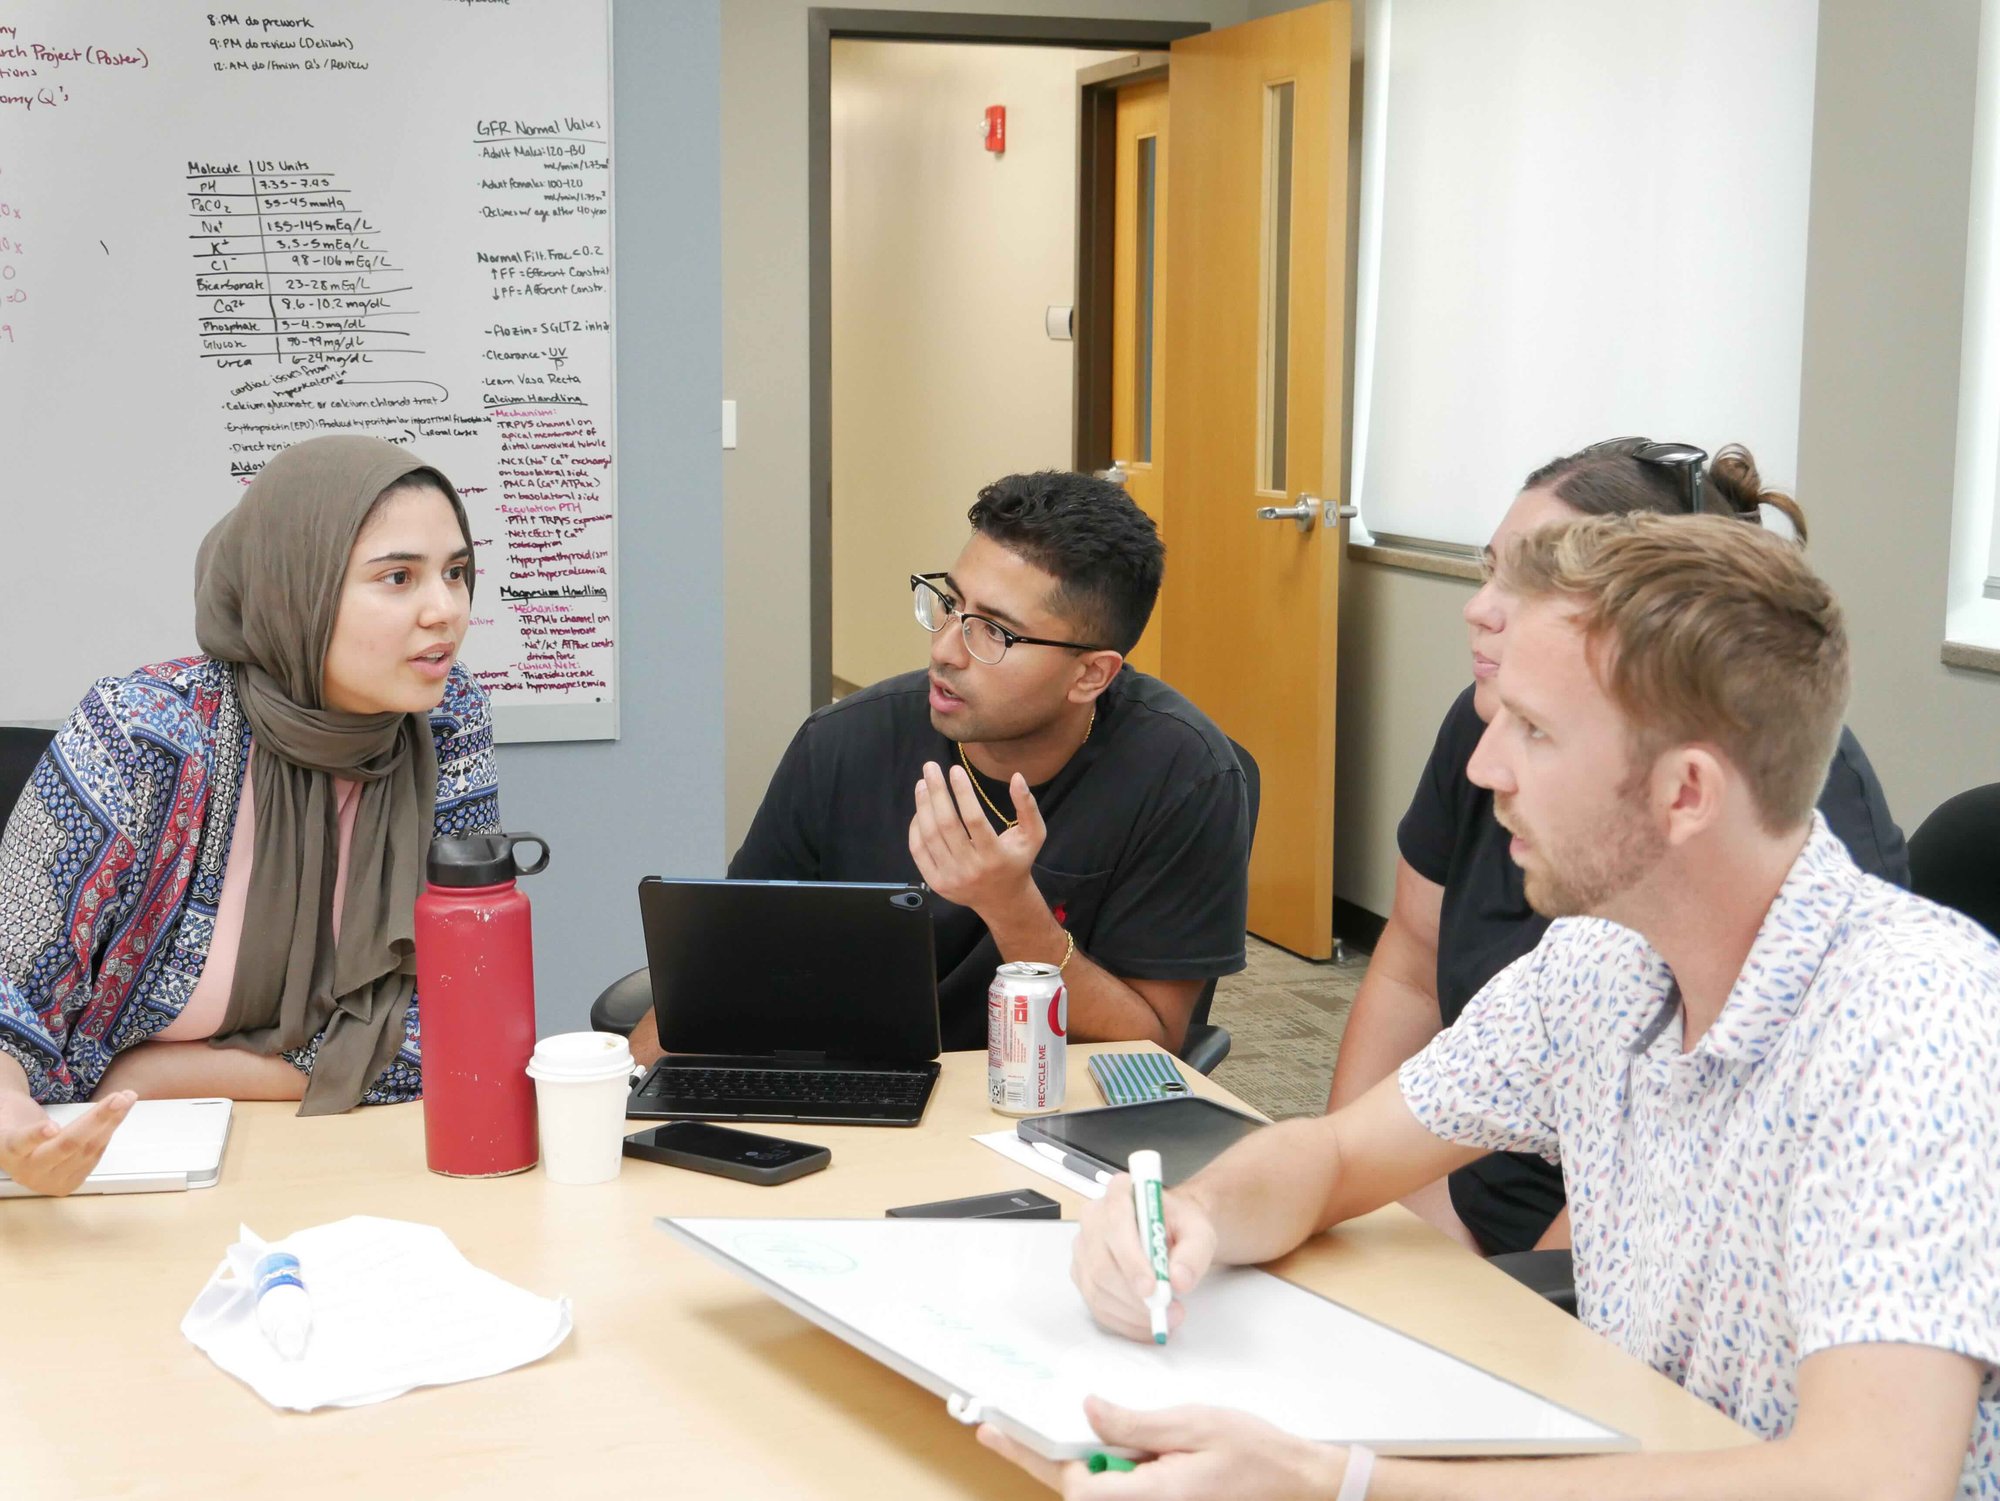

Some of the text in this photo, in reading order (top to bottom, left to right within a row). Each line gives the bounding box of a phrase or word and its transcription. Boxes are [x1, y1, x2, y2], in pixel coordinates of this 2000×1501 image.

[246, 16, 260, 26] do
[262, 17, 314, 32] prework
[245, 38, 258, 49] do
[260, 40, 296, 49] review
[299, 37, 354, 51] (Delilah)
[30, 44, 82, 69] Project
[86, 45, 149, 68] (Poster)
[477, 120, 511, 136] GFR
[515, 120, 560, 136] Normal
[482, 146, 511, 159] Adult
[187, 160, 310, 175] Molecule US Units
[534, 209, 550, 223] age
[477, 251, 522, 264] Normal
[196, 277, 265, 292] Bicarbonate
[203, 321, 261, 335] Phosphate
[540, 320, 582, 334] SGLT2
[217, 358, 253, 369] Urea
[231, 379, 271, 397] cardiac
[301, 363, 330, 377] from
[485, 373, 582, 386] Learn Vasa Recta
[317, 401, 328, 409] or
[483, 392, 583, 404] Calcium Handling
[536, 418, 575, 429] channel
[501, 432, 532, 442] apical
[586, 428, 597, 437] of
[503, 492, 517, 500] on
[577, 493, 600, 502] side
[559, 501, 582, 514] PTH
[508, 514, 529, 525] PTH
[562, 583, 608, 602] Handling
[597, 615, 610, 623] on
[520, 627, 547, 640] apical
[1038, 1044, 1046, 1108] RECYCLE ME
